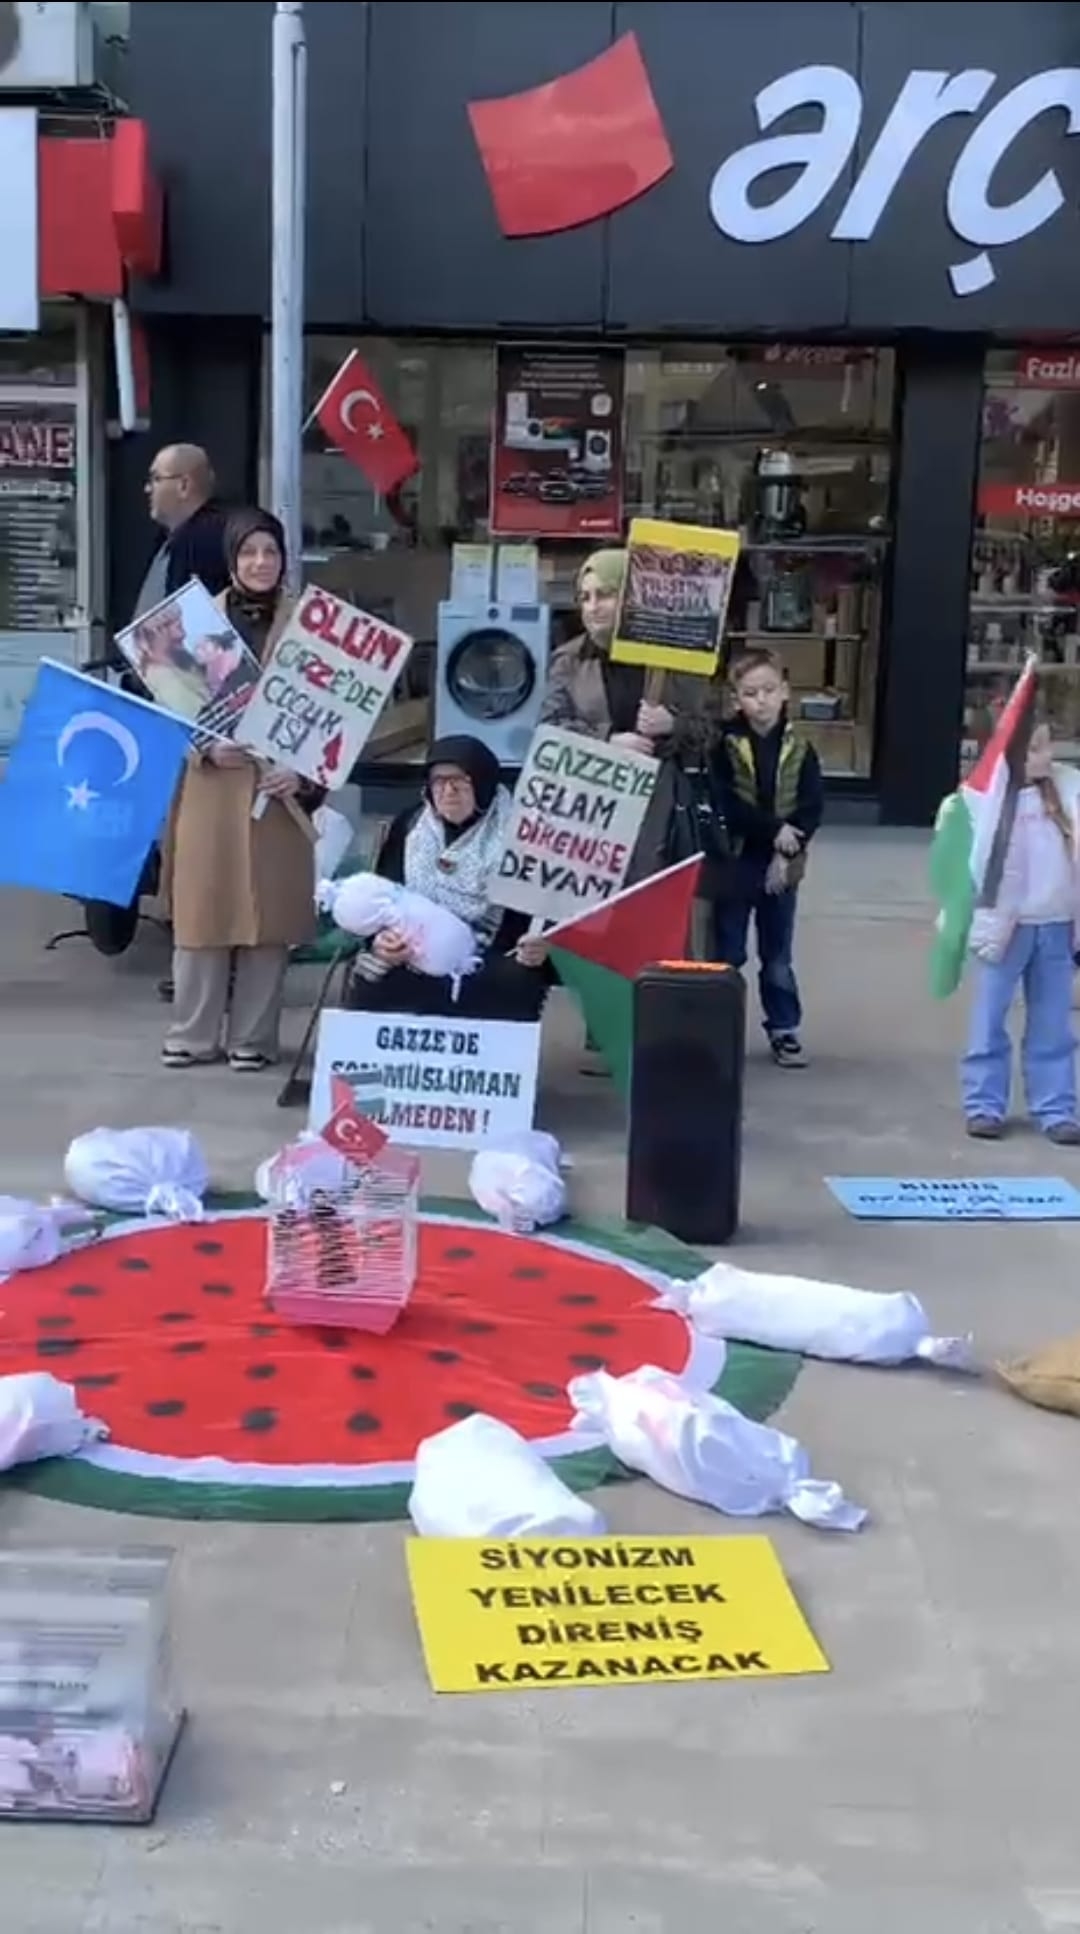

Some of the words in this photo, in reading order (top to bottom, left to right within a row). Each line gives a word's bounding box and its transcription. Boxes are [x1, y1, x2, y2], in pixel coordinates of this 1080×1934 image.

[300, 590, 403, 670] ÖLÜM
[521, 774, 618, 830] SELAM
[499, 850, 614, 898] DEVAM
[480, 1542, 696, 1570] SİYONİZM
[470, 1580, 727, 1608] YENİLECEK
[517, 1614, 704, 1644] DİRENİŞ
[475, 1651, 771, 1684] KAZANACAK
